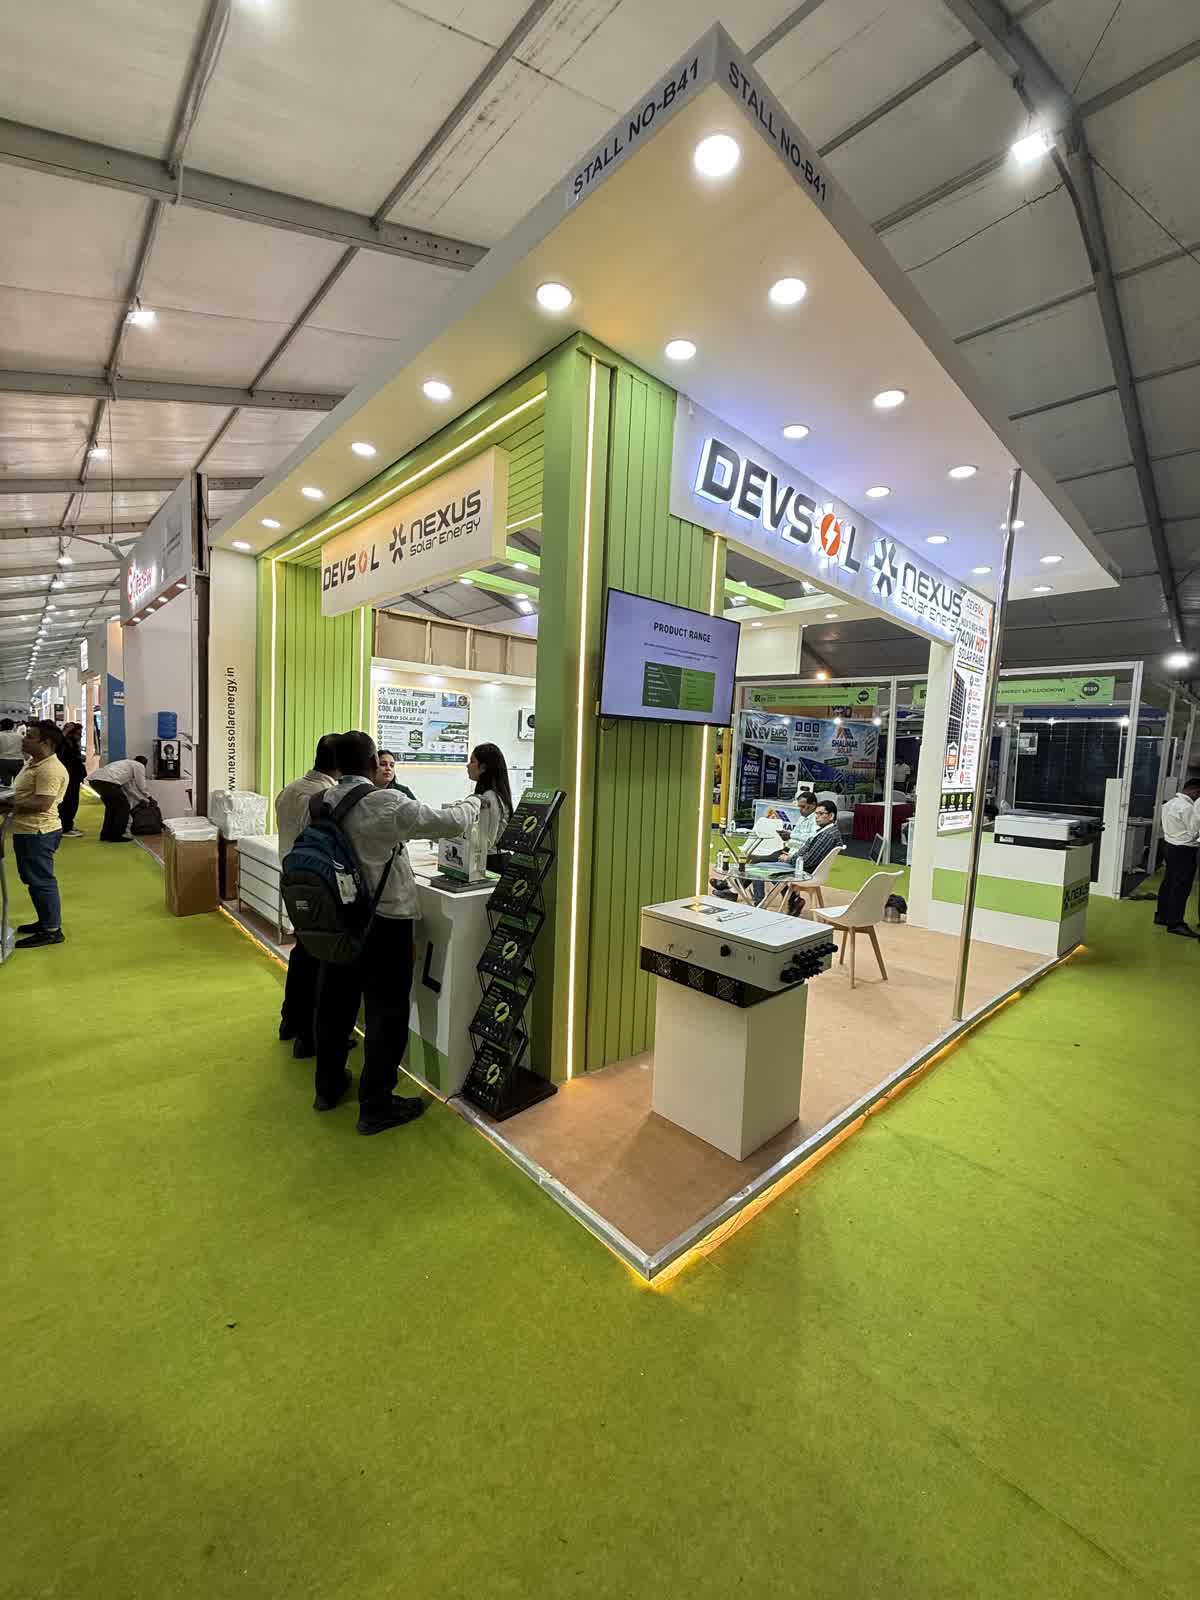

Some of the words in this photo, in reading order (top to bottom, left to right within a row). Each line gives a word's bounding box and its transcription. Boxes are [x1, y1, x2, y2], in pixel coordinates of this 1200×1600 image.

[573, 137, 623, 195] STALL
[629, 57, 700, 142] NO-B41
[729, 61, 776, 139] STALL
[781, 127, 827, 201] NO-B41
[695, 437, 862, 575] DEVSOL
[322, 544, 380, 592] DEVSOL
[653, 622, 688, 639] PRODUCT
[689, 629, 711, 643] RANGE
[378, 697, 397, 705] SOLAR
[771, 728, 787, 737] EXPO
